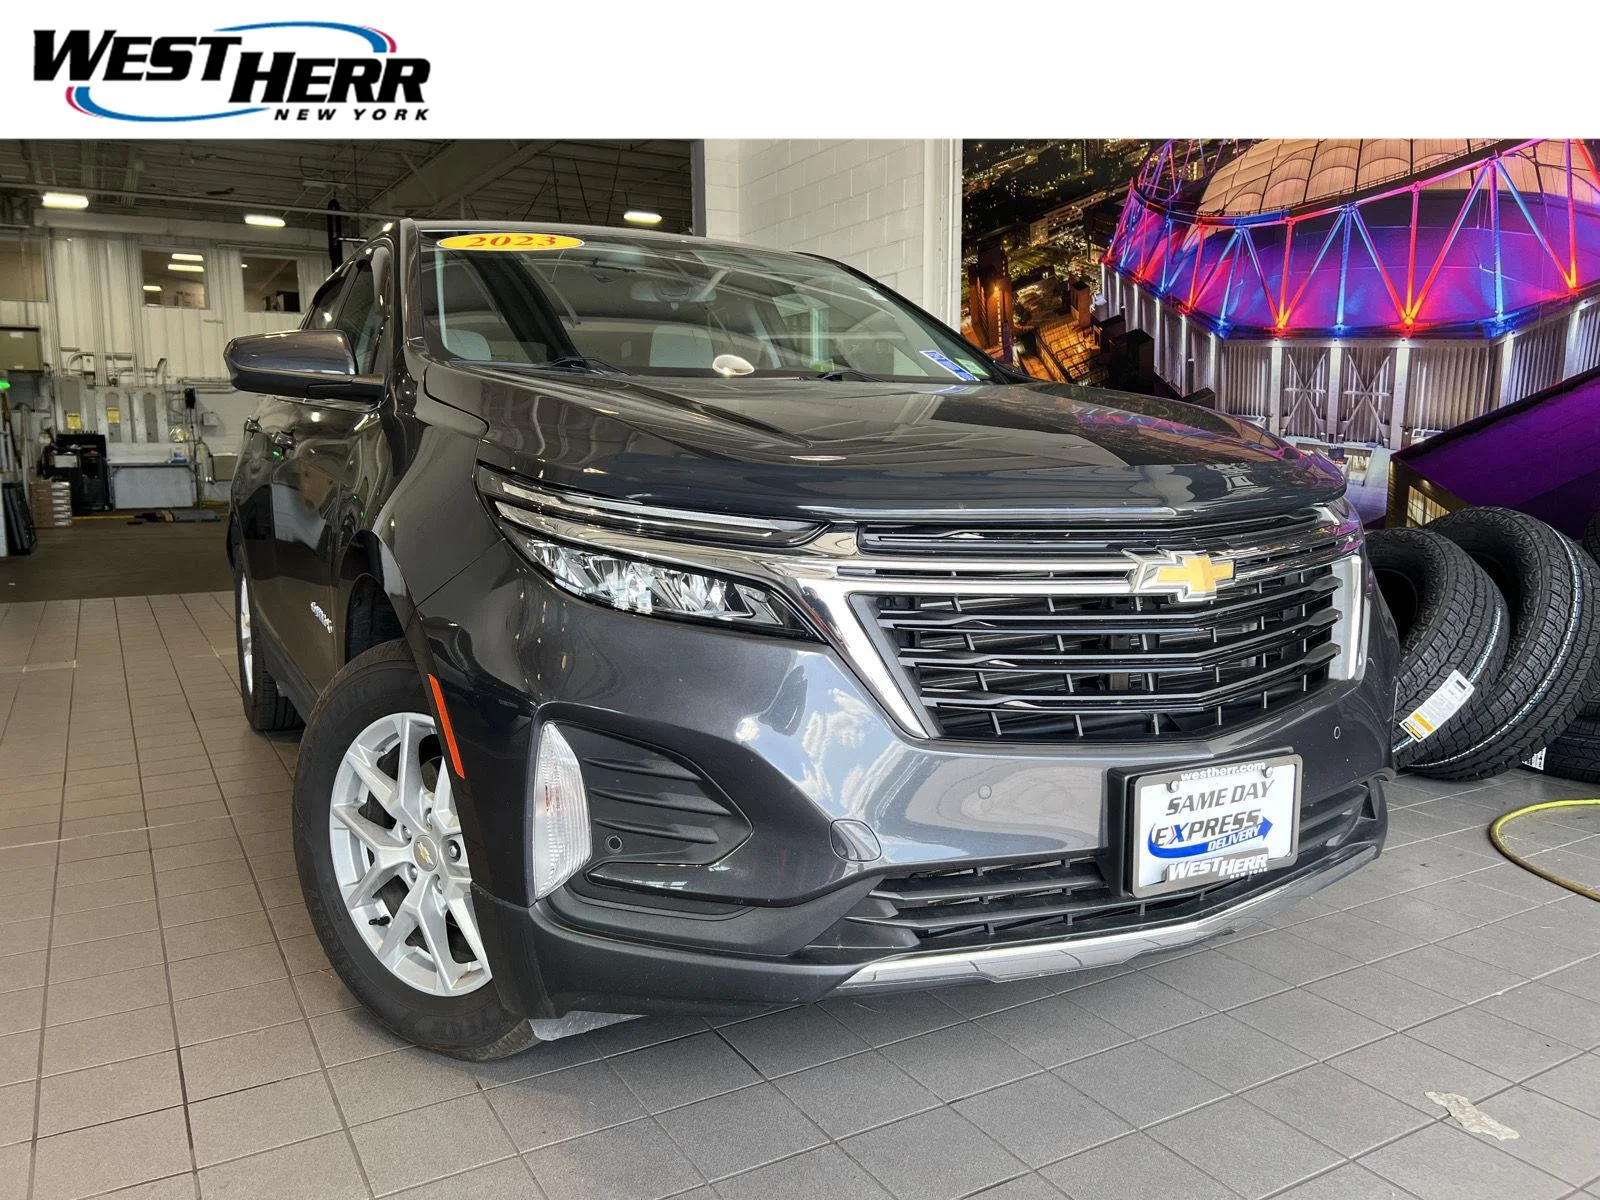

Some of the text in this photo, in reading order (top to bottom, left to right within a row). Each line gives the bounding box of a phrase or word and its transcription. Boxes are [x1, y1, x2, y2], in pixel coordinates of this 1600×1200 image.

[465, 236, 557, 247] 2023
[1180, 762, 1266, 781] westherr.com
[1165, 779, 1275, 816] SAME DAY
[1153, 809, 1262, 847] EXPRESS
[1207, 826, 1261, 852] DELIVERY
